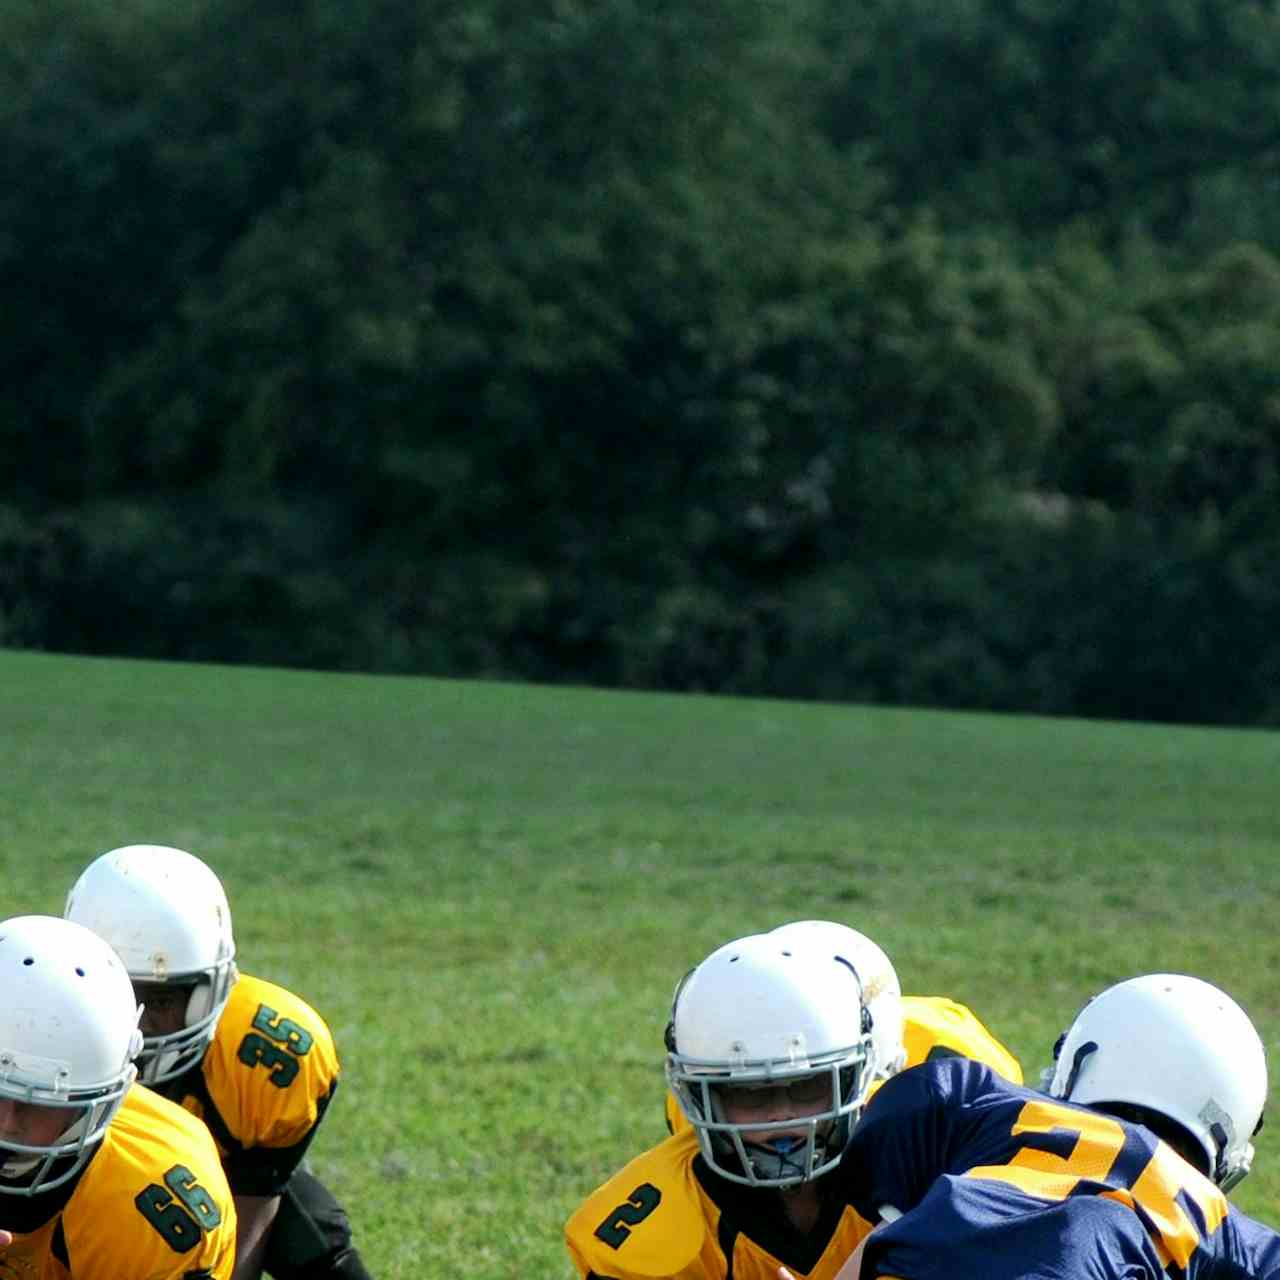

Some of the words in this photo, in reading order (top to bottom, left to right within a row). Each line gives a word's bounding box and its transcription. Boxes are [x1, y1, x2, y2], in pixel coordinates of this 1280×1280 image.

[237, 1003, 315, 1089] 35
[134, 1163, 222, 1254] 66
[593, 1182, 662, 1251] 2
